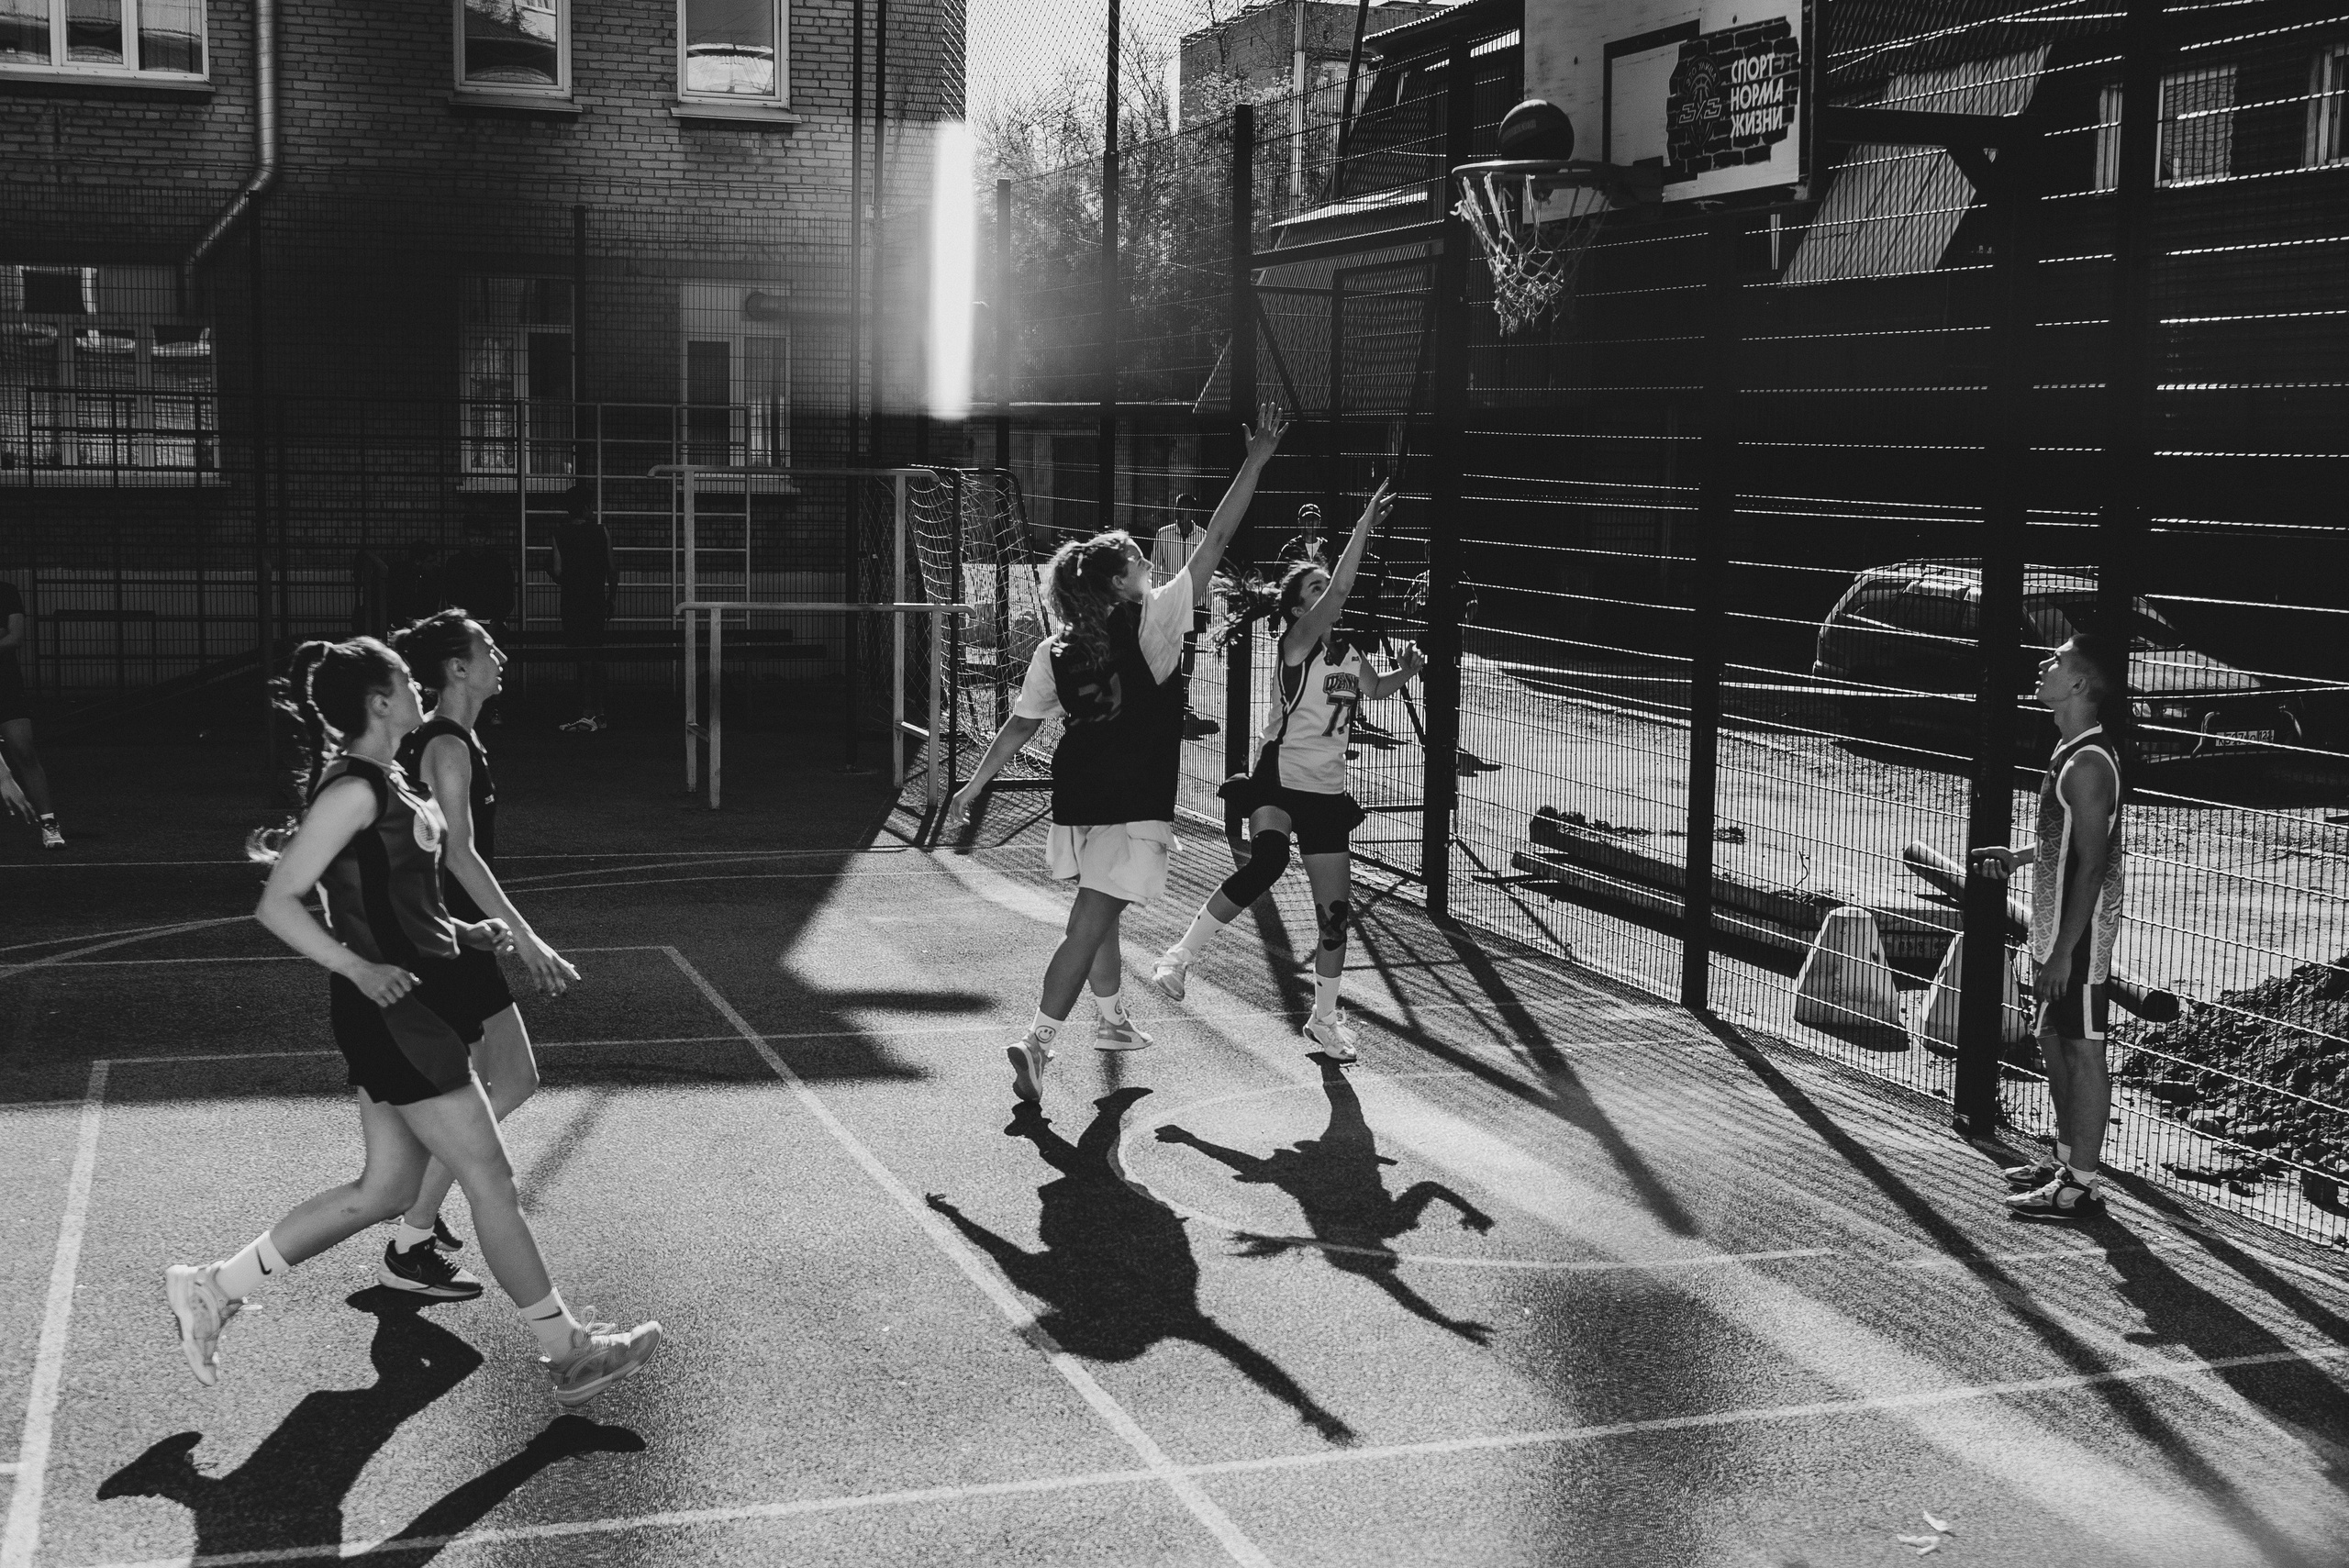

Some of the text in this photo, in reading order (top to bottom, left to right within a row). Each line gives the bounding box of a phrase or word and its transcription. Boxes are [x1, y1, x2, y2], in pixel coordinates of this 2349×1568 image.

[1731, 52, 1776, 83] СПОРТ
[1731, 77, 1784, 111] НОРМА
[1730, 106, 1783, 138] ЖИЗНИ
